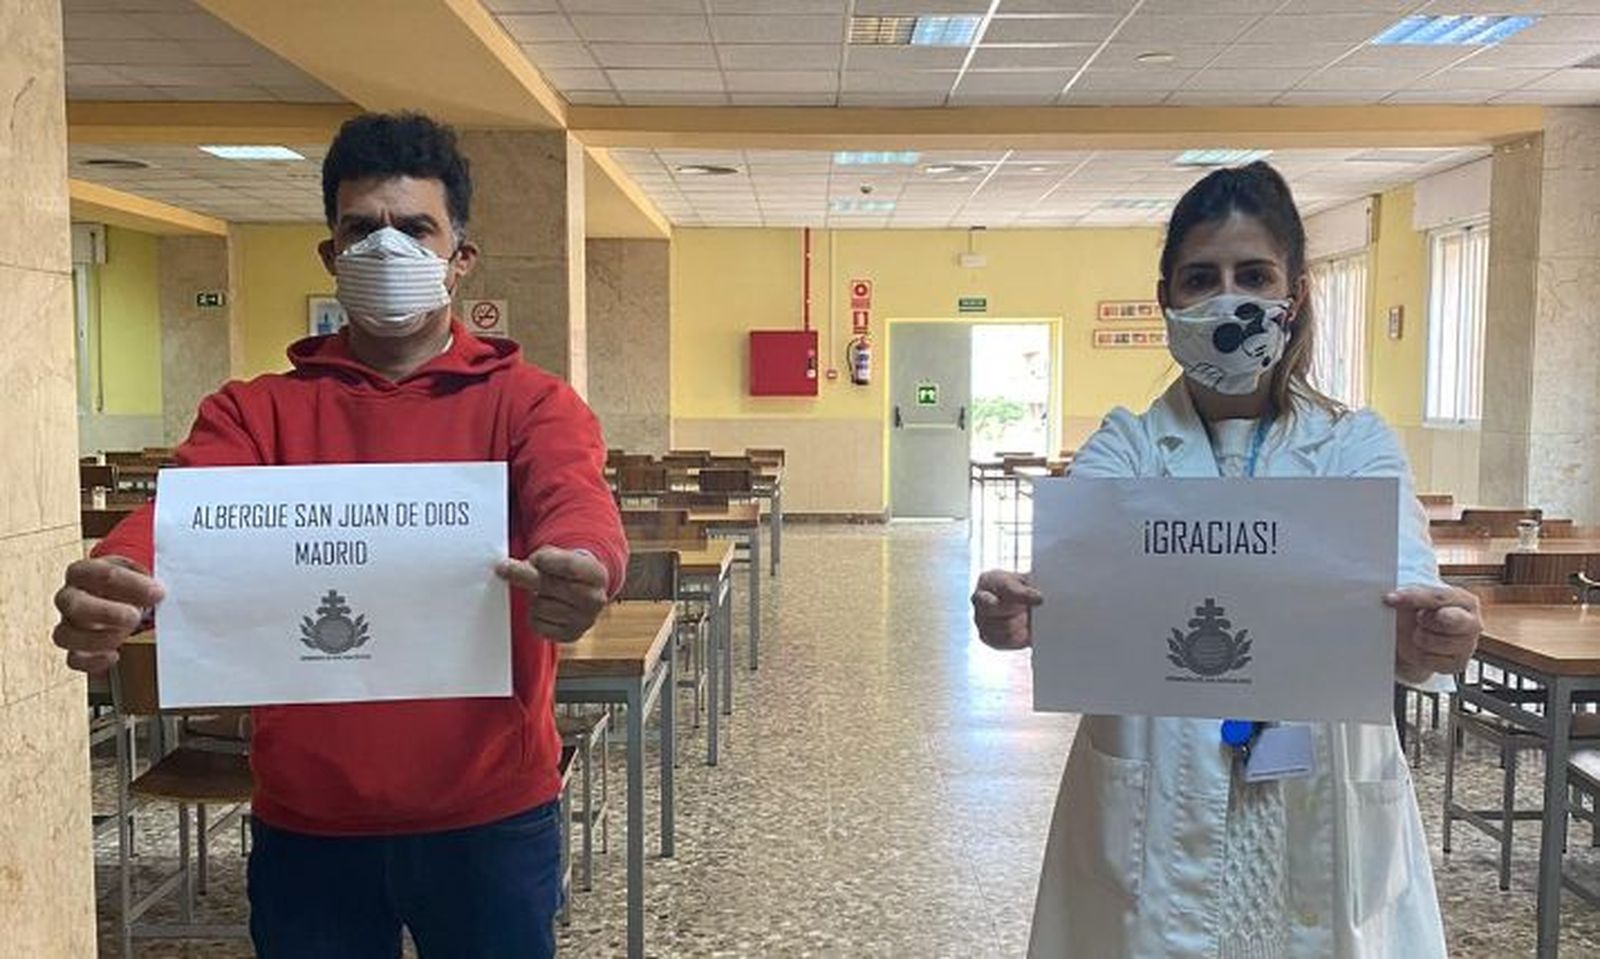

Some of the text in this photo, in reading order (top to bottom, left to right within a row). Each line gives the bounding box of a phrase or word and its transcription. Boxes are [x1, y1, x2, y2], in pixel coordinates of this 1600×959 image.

[192, 501, 470, 529] ALBERGUE SAN JUAN DE DIOS
[1144, 520, 1277, 555] ¡GRACIAS!
[294, 540, 367, 566] MADRID
